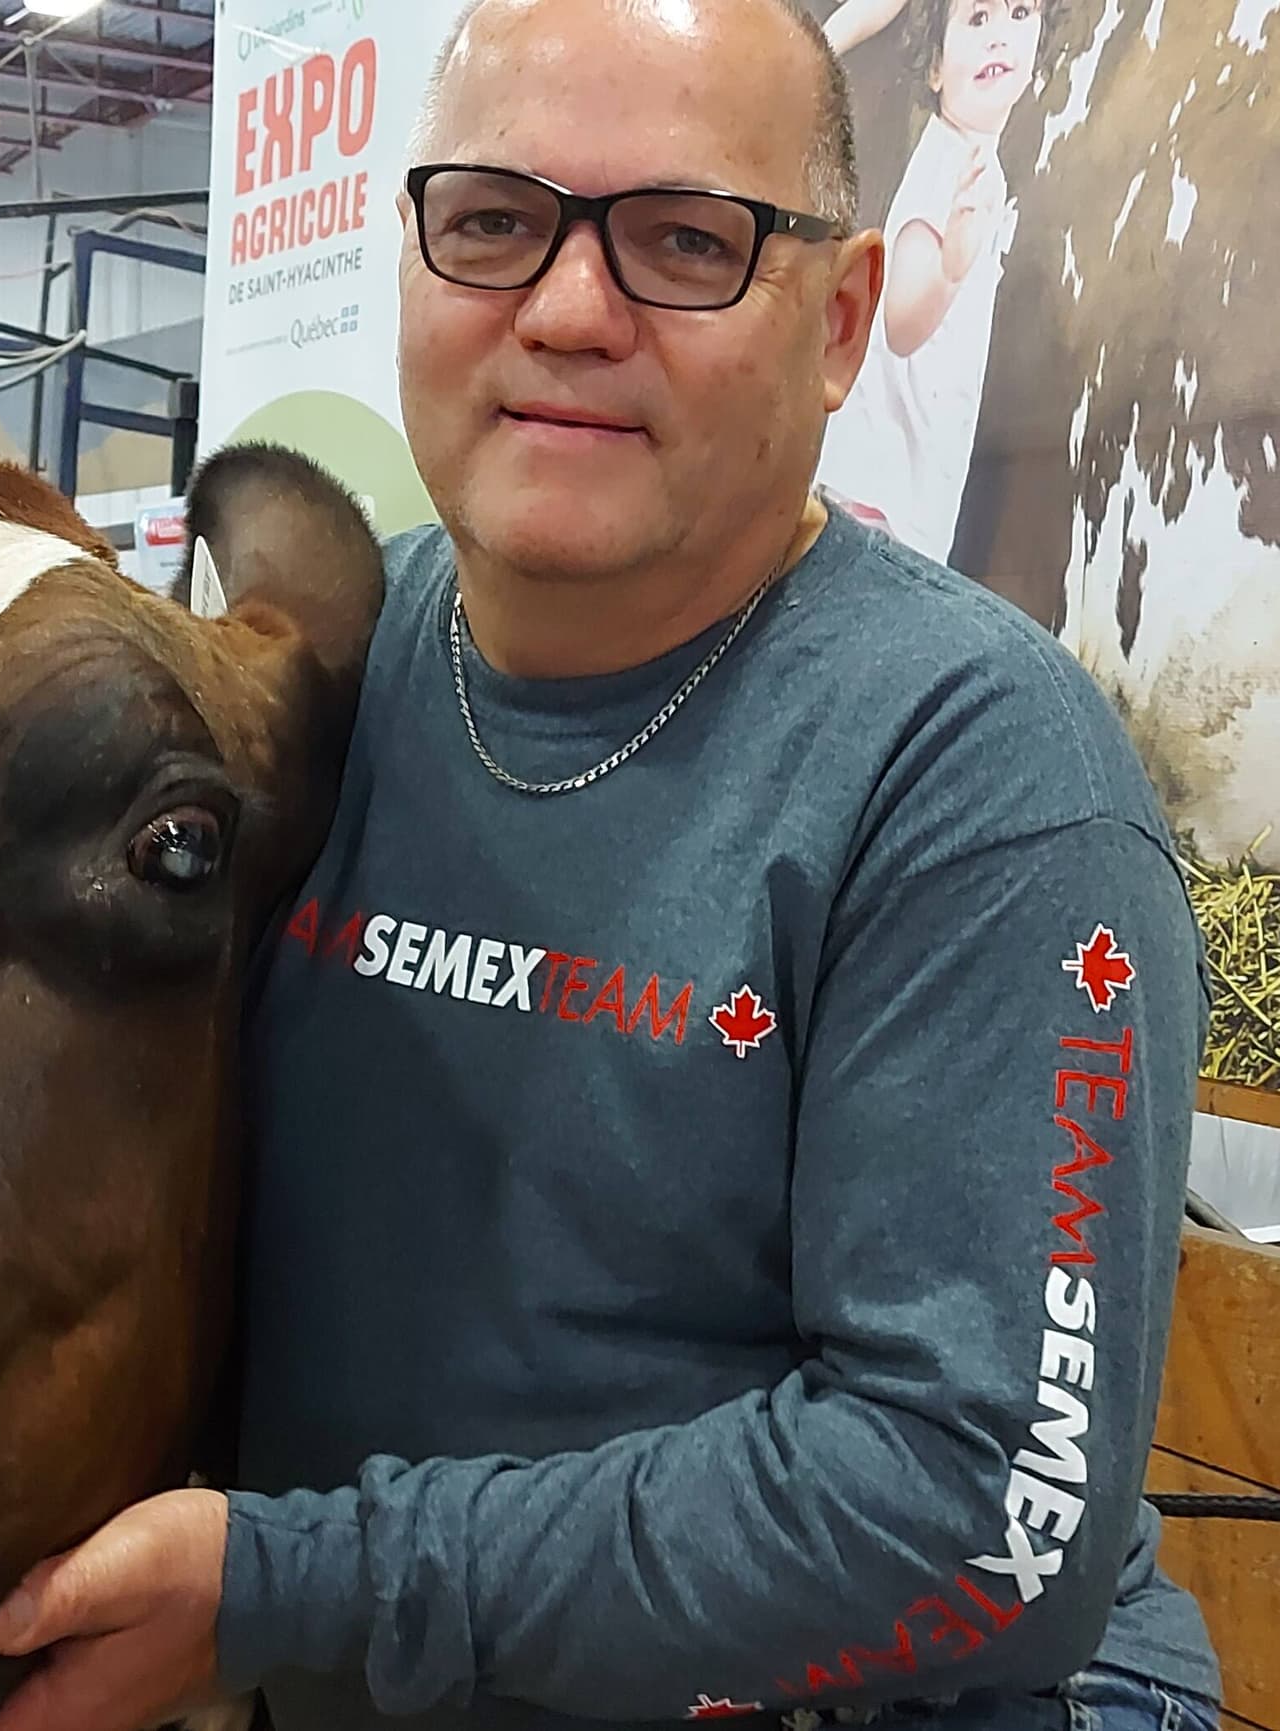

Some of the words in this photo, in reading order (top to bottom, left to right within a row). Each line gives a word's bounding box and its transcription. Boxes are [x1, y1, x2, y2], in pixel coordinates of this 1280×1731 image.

[235, 37, 377, 197] EXPO
[231, 171, 368, 267] AGRICOLE
[228, 278, 244, 305] DE
[246, 247, 363, 300] SAINT-HYACINTHE
